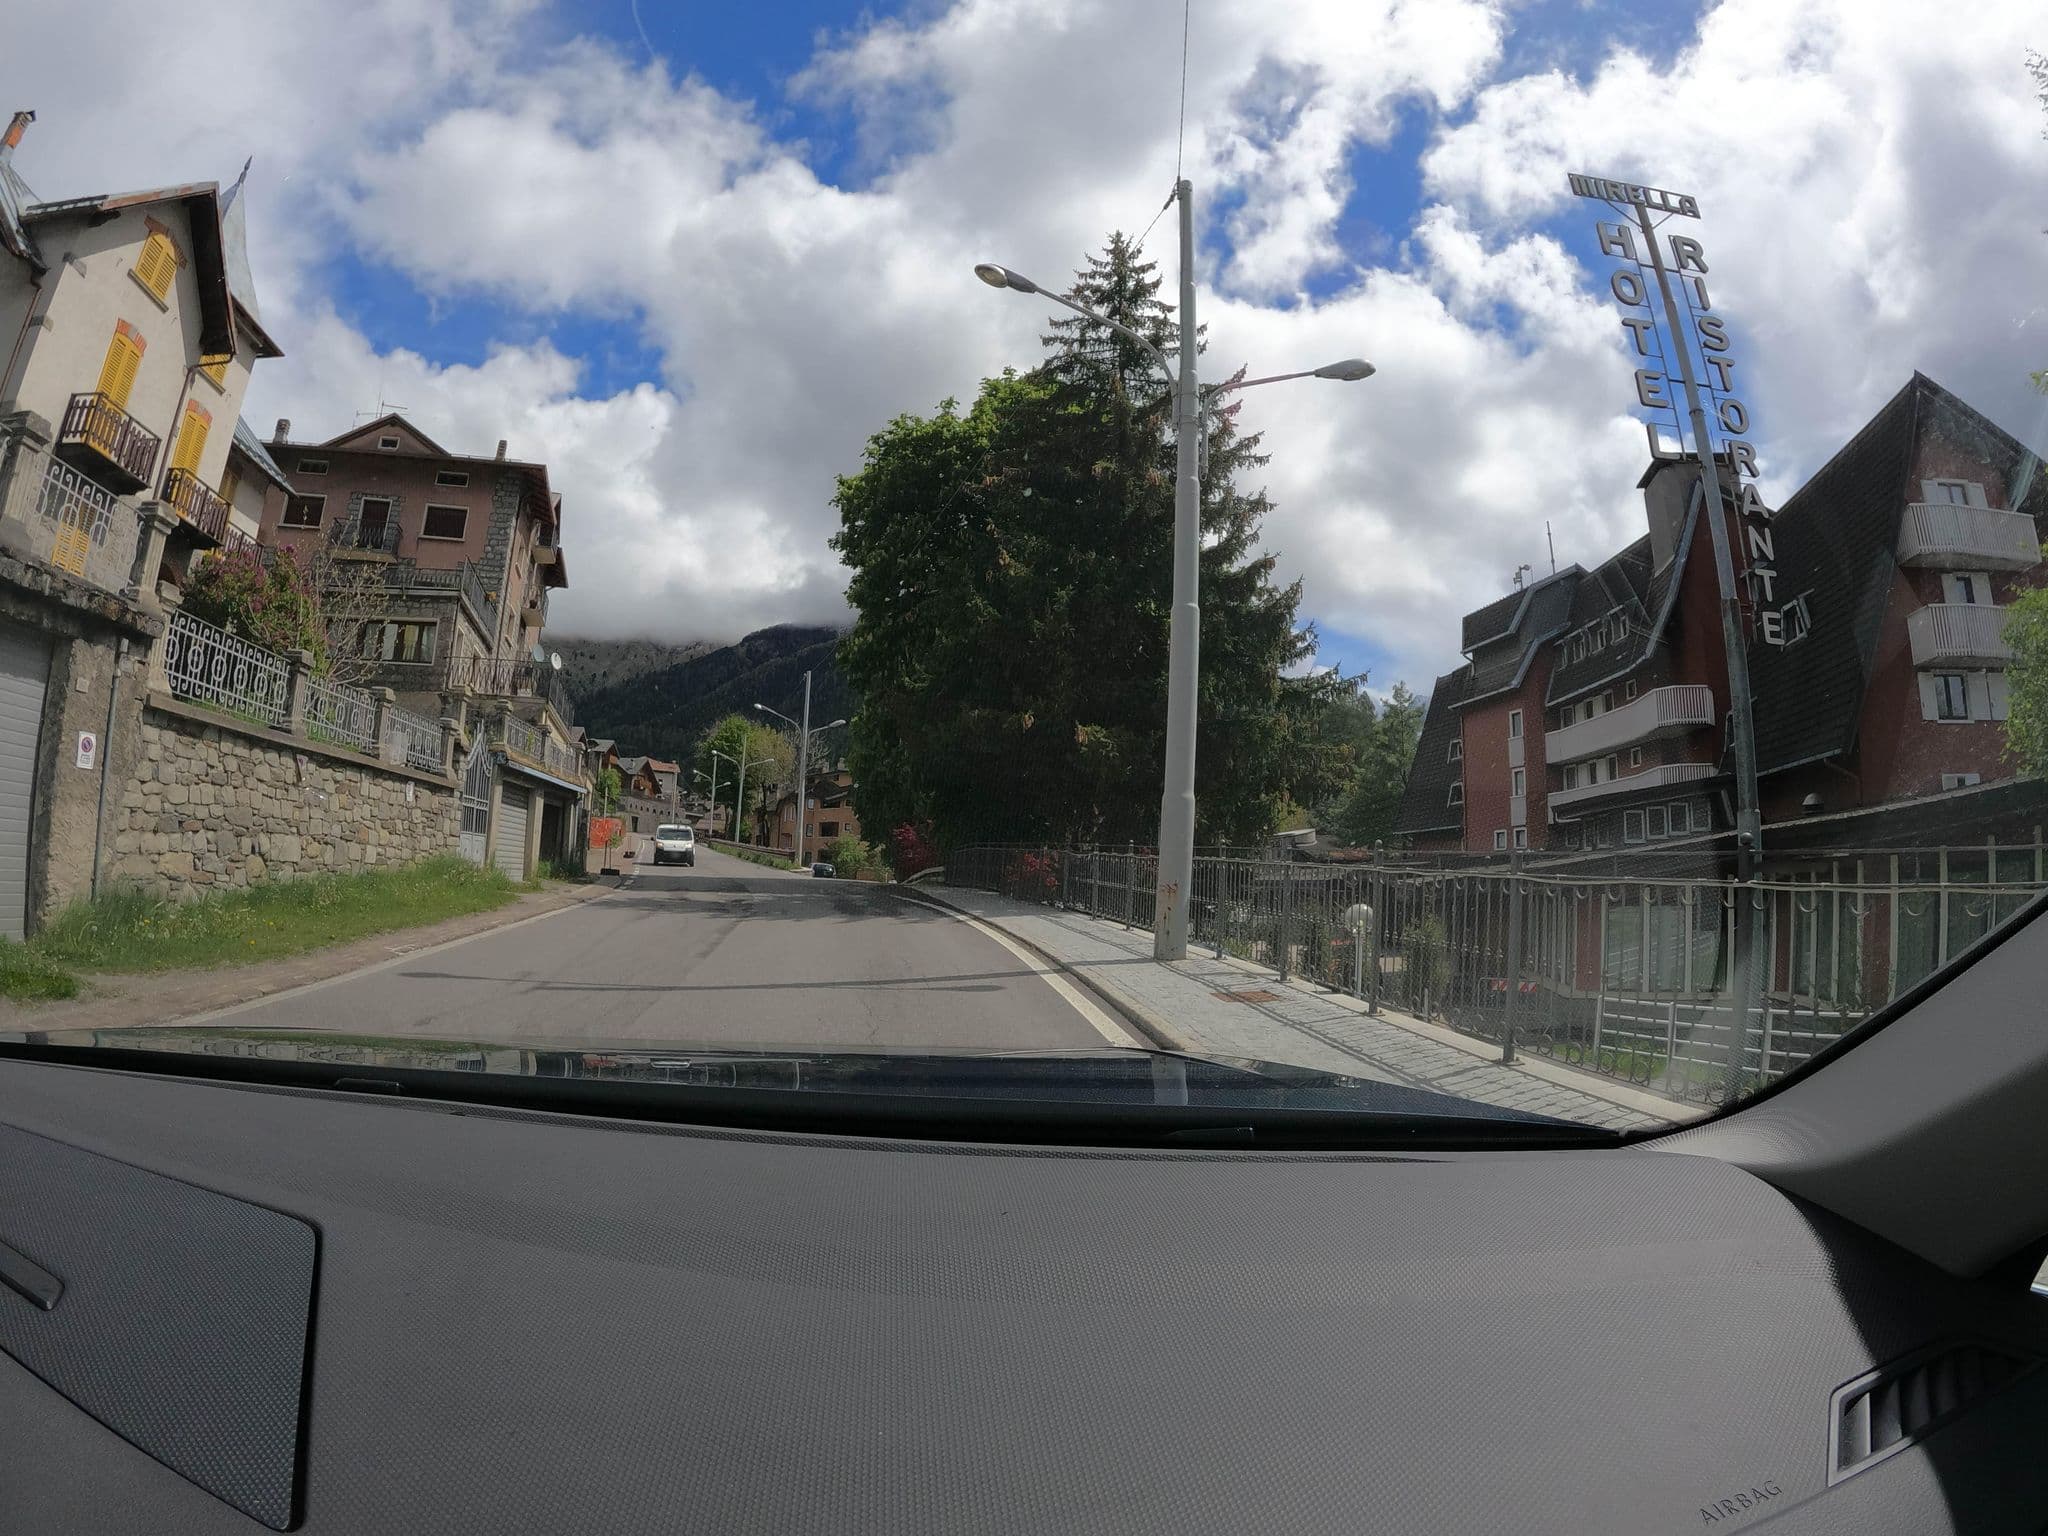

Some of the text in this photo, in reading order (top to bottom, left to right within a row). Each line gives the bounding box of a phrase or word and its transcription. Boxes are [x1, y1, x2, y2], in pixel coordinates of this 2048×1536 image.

[1570, 174, 1700, 218] MIRELLA
[1597, 220, 1681, 461] HOTEL
[1671, 234, 1785, 646] RISTORANTE
[1700, 1479, 1782, 1525] AIRBAG
